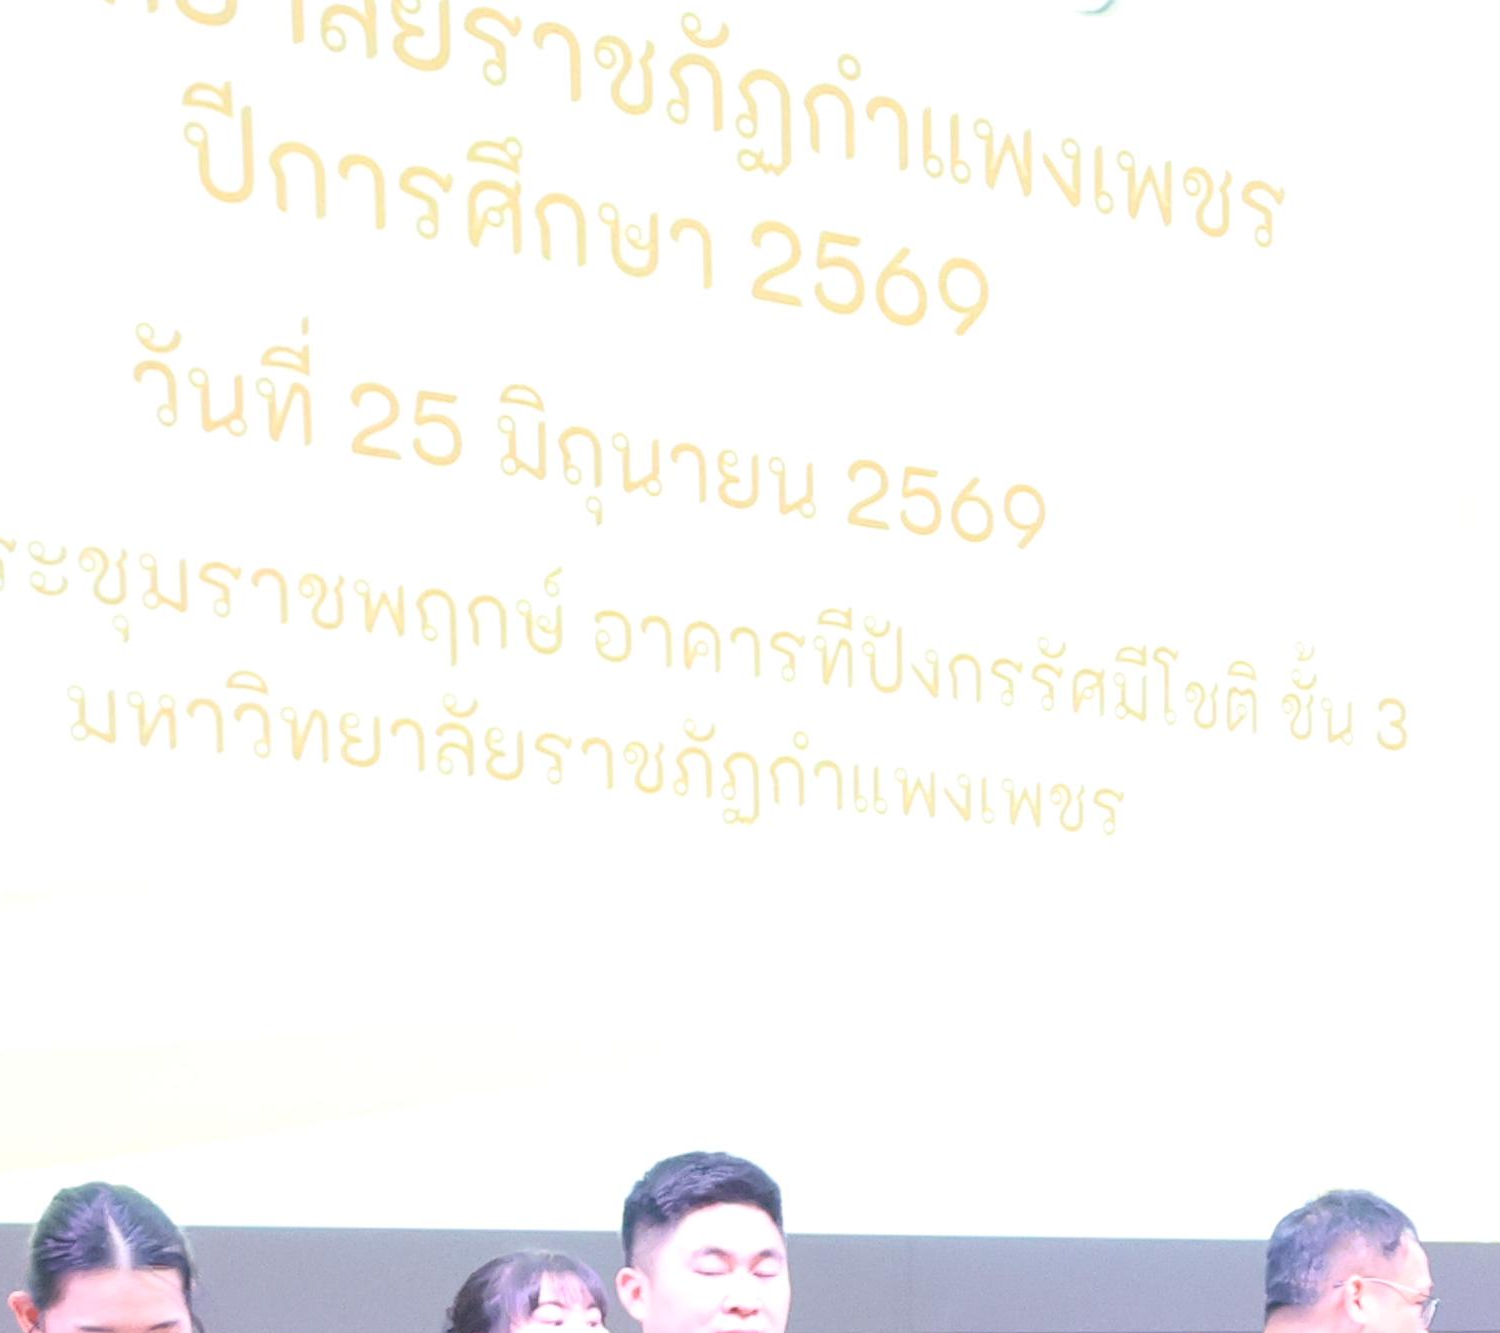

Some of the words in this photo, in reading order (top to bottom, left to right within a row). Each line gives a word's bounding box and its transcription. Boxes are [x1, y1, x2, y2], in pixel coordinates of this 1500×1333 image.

[104, 0, 1285, 248] ลยราชภัฏกำแพงเพชร
[182, 80, 713, 289] ปีการศึกษา
[751, 220, 989, 336] 2569
[133, 316, 313, 447] วันที่
[350, 381, 462, 467] 25
[498, 384, 816, 526] มิถุนายน
[847, 459, 1046, 549] 2569
[68, 670, 1124, 836] มหาวิทยาลัยราชภัฏกำแพงเพชร
[595, 608, 1257, 732] อาคารทีปังกรรัศมีโชติ
[1282, 650, 1353, 746] ชั้น
[1377, 697, 1408, 751] 3
